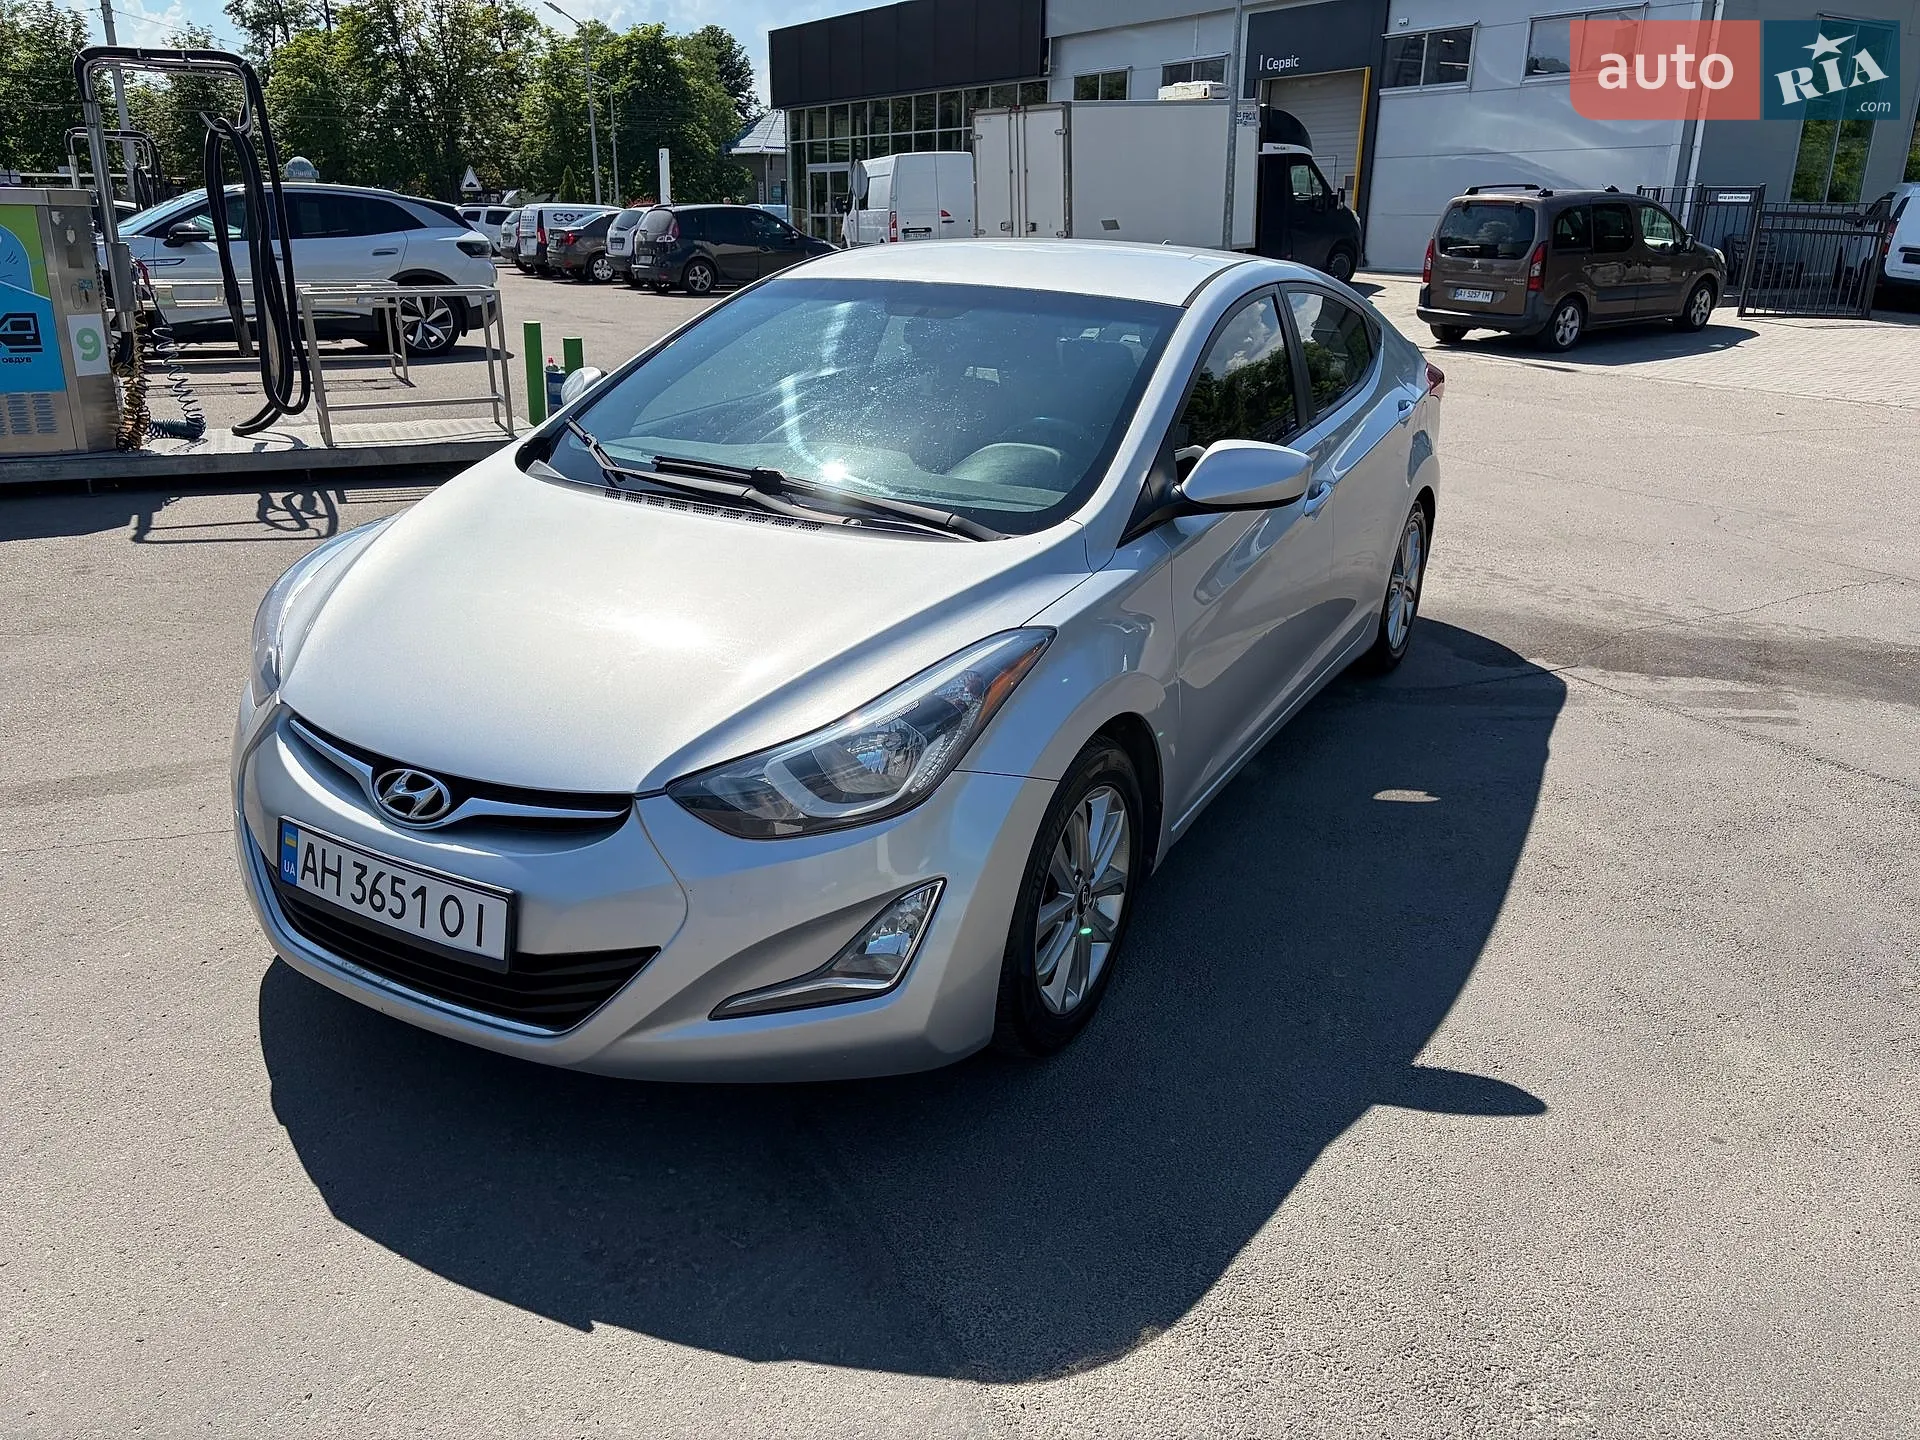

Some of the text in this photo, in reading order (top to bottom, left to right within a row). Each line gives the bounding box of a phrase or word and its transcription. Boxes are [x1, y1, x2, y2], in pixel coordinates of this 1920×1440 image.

[1266, 54, 1300, 72] Сервіс
[76, 327, 102, 362] 9
[2, 356, 32, 364] ОБДУВ
[283, 859, 296, 877] UA
[300, 842, 484, 947] AH 3651 OI
